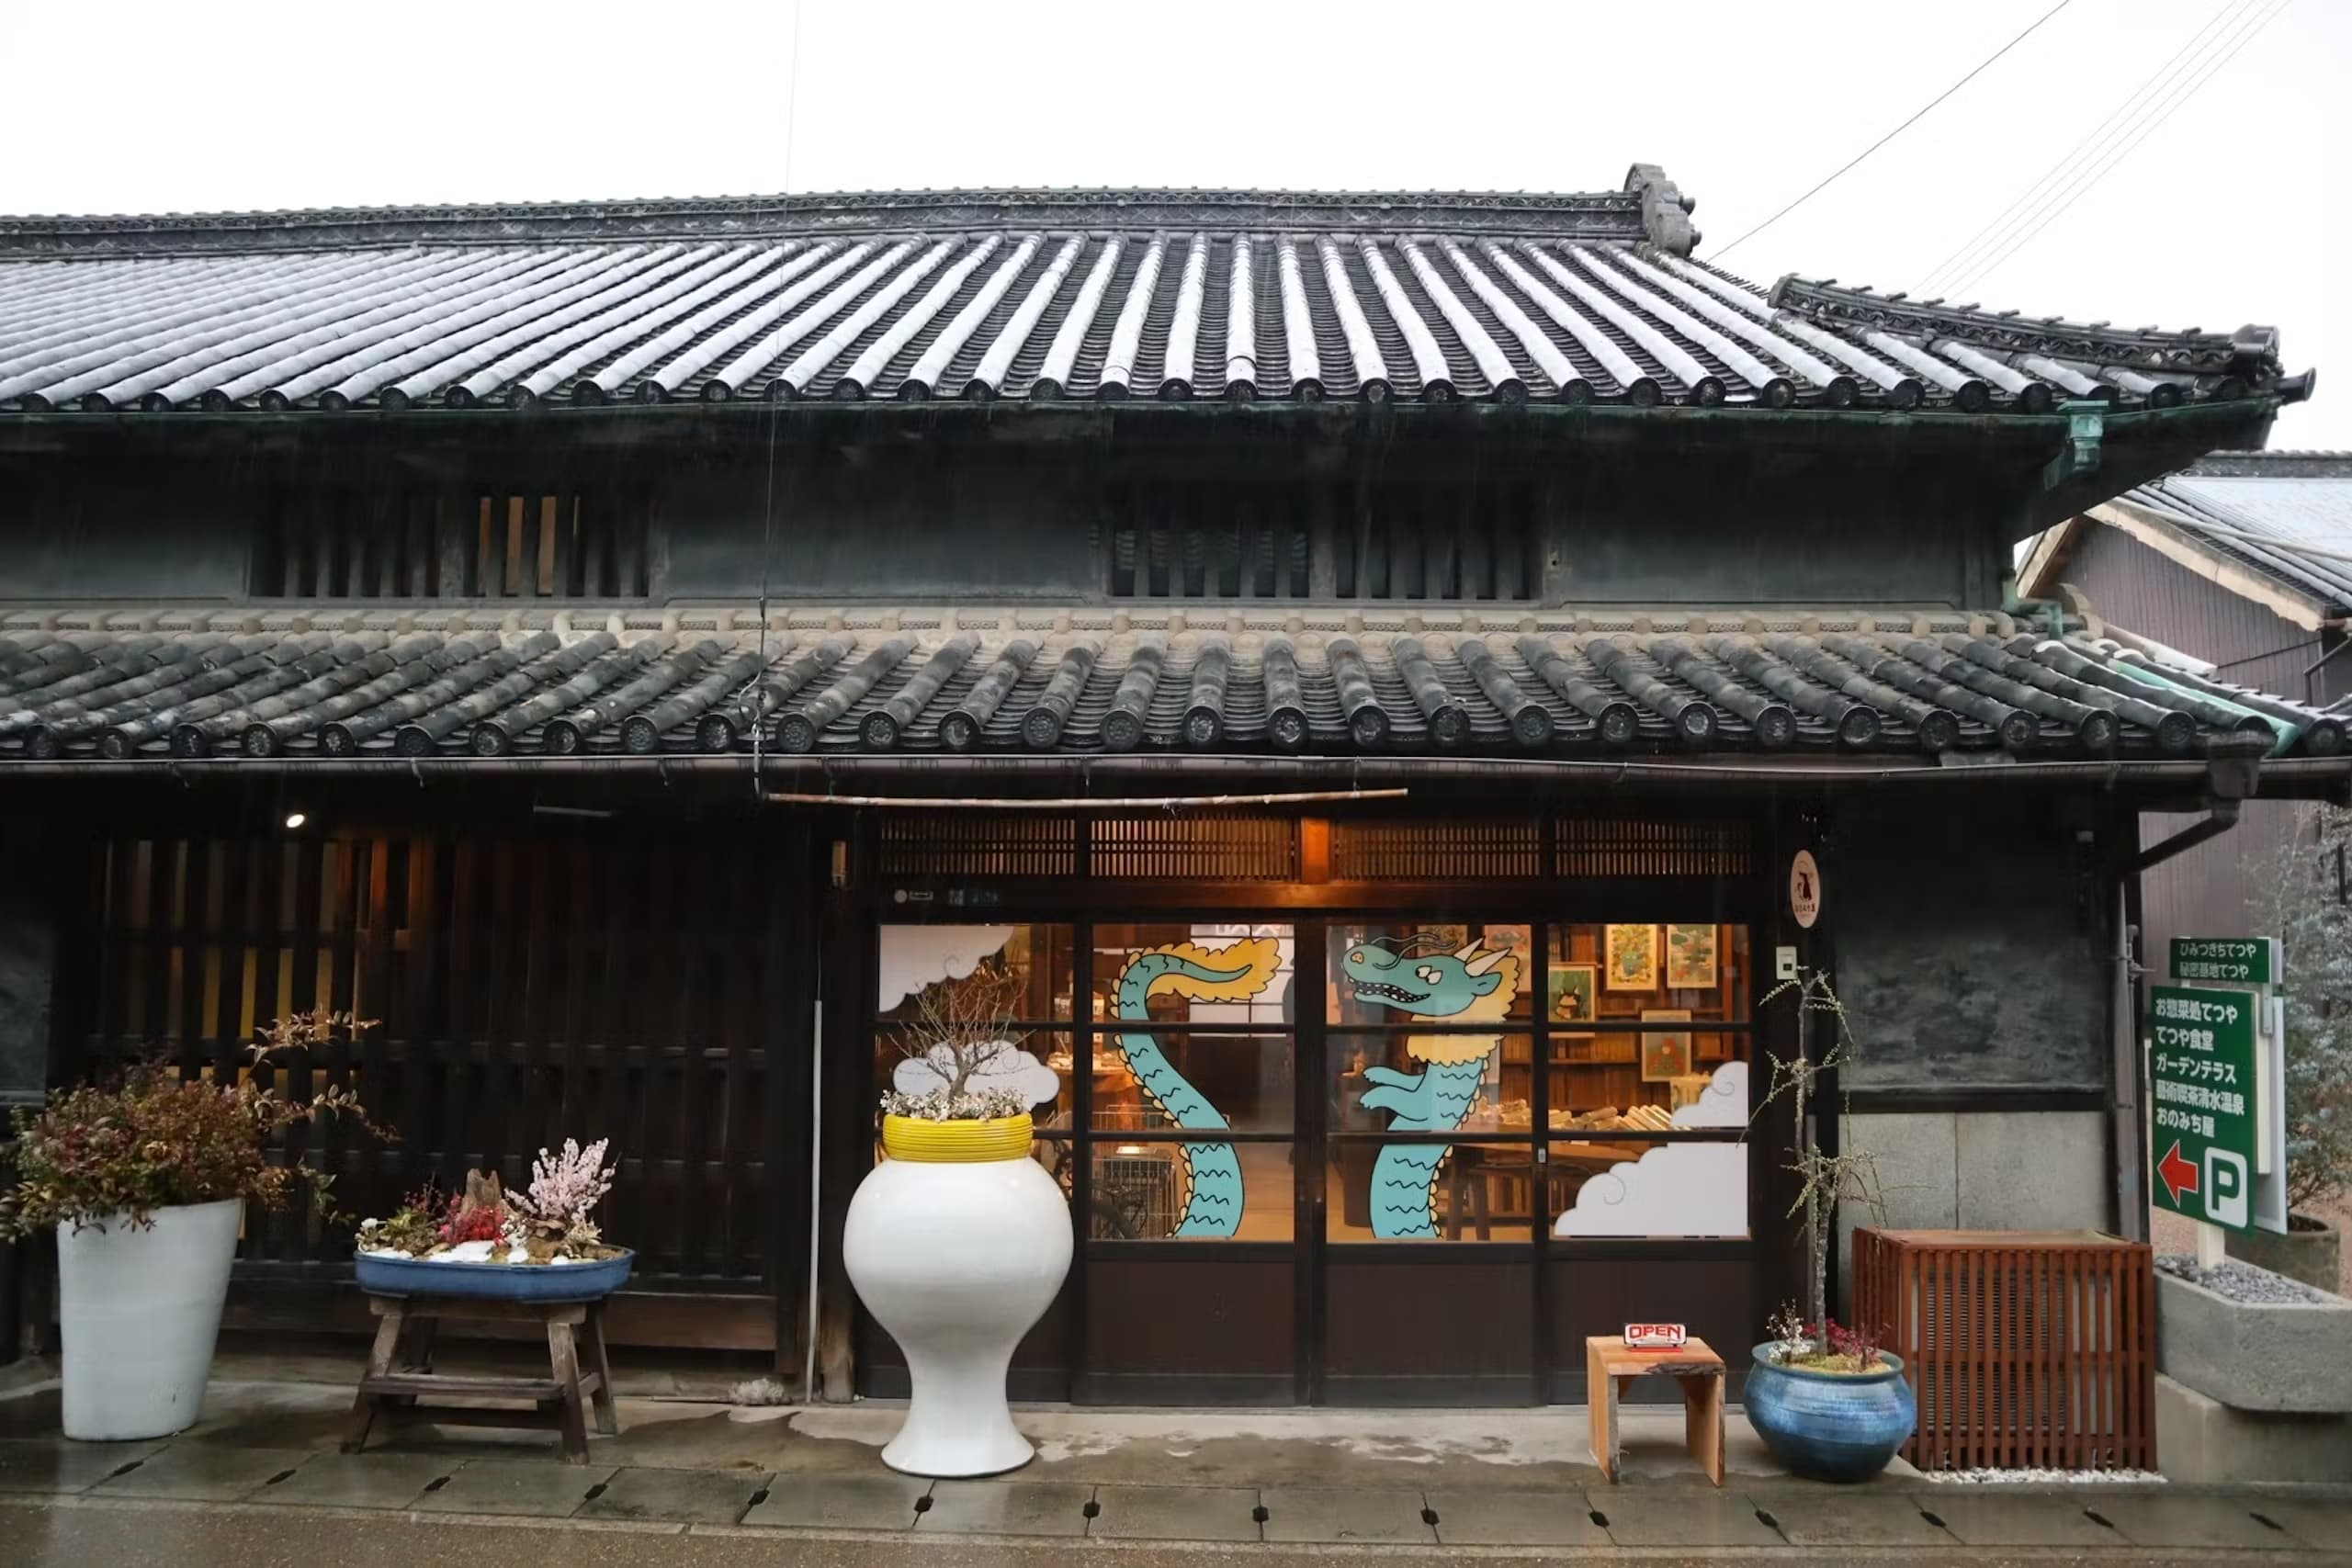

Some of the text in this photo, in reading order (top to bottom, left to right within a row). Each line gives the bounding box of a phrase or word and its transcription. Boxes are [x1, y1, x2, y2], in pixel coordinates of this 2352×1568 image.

[2180, 942, 2256, 959] ひみつきちてつや
[2155, 998, 2238, 1024] お惣菜処てつや
[2155, 1026, 2214, 1051] てつや食堂
[2156, 1054, 2236, 1084] ガーデンテラス
[2156, 1107, 2215, 1138] おのみち屋
[2211, 1156, 2240, 1212] P
[1629, 1325, 1680, 1339] OPEN
